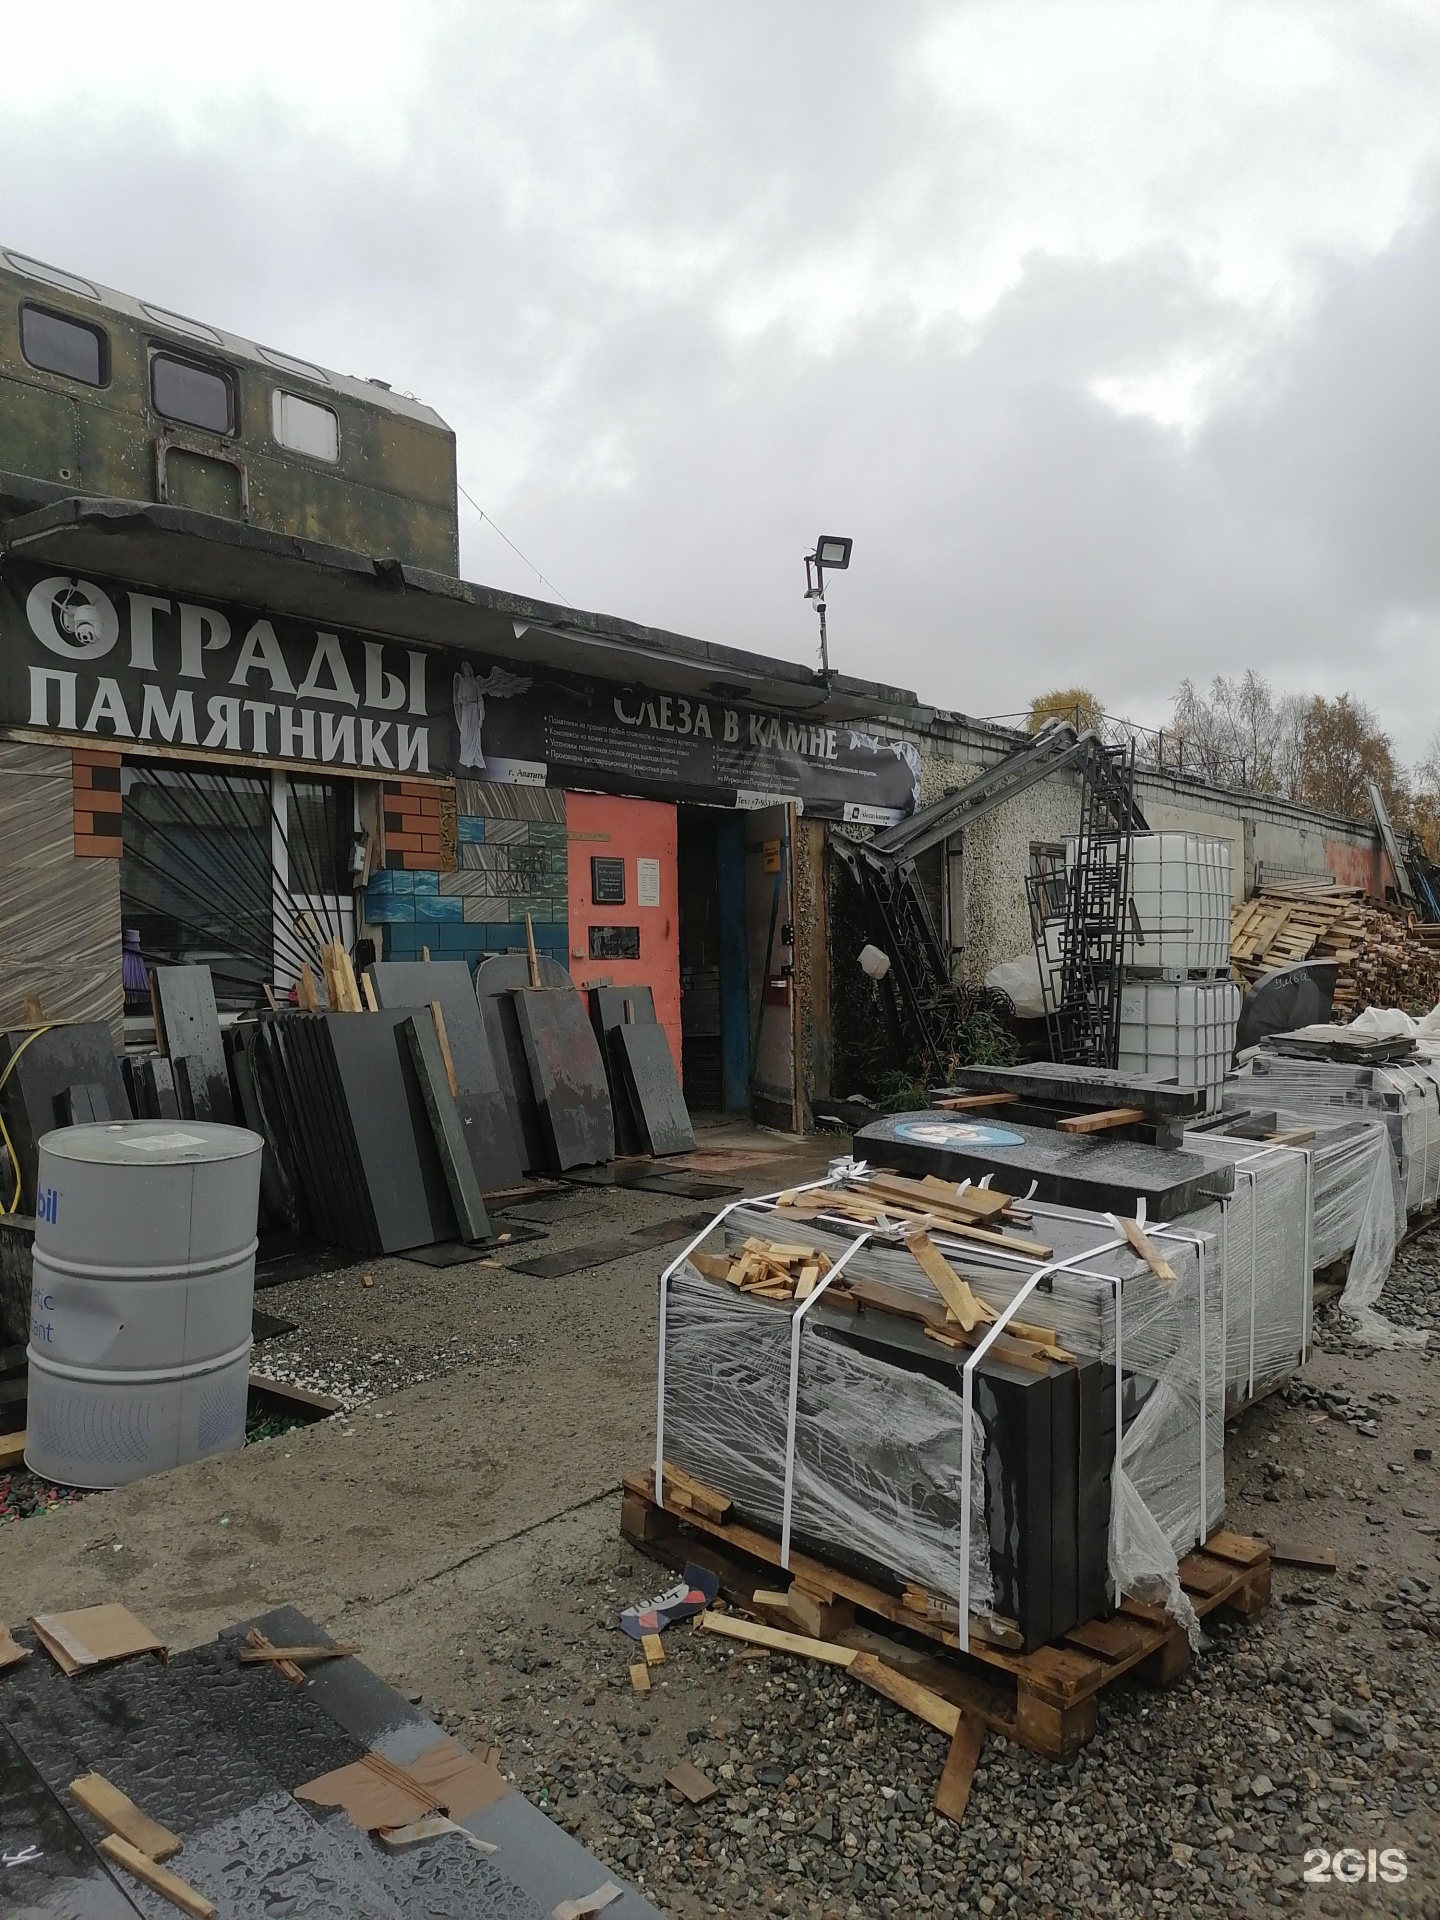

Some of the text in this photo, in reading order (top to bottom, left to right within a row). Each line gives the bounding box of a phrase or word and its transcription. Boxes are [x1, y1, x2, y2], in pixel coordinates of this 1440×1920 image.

[26, 577, 428, 717] ОГРАДЫ
[28, 666, 430, 774] ПАМЯТНИКИ
[549, 715, 578, 727] Памятники
[614, 695, 838, 760] СЛЕЗА В КАМНЕ
[517, 769, 547, 780] Апатиты
